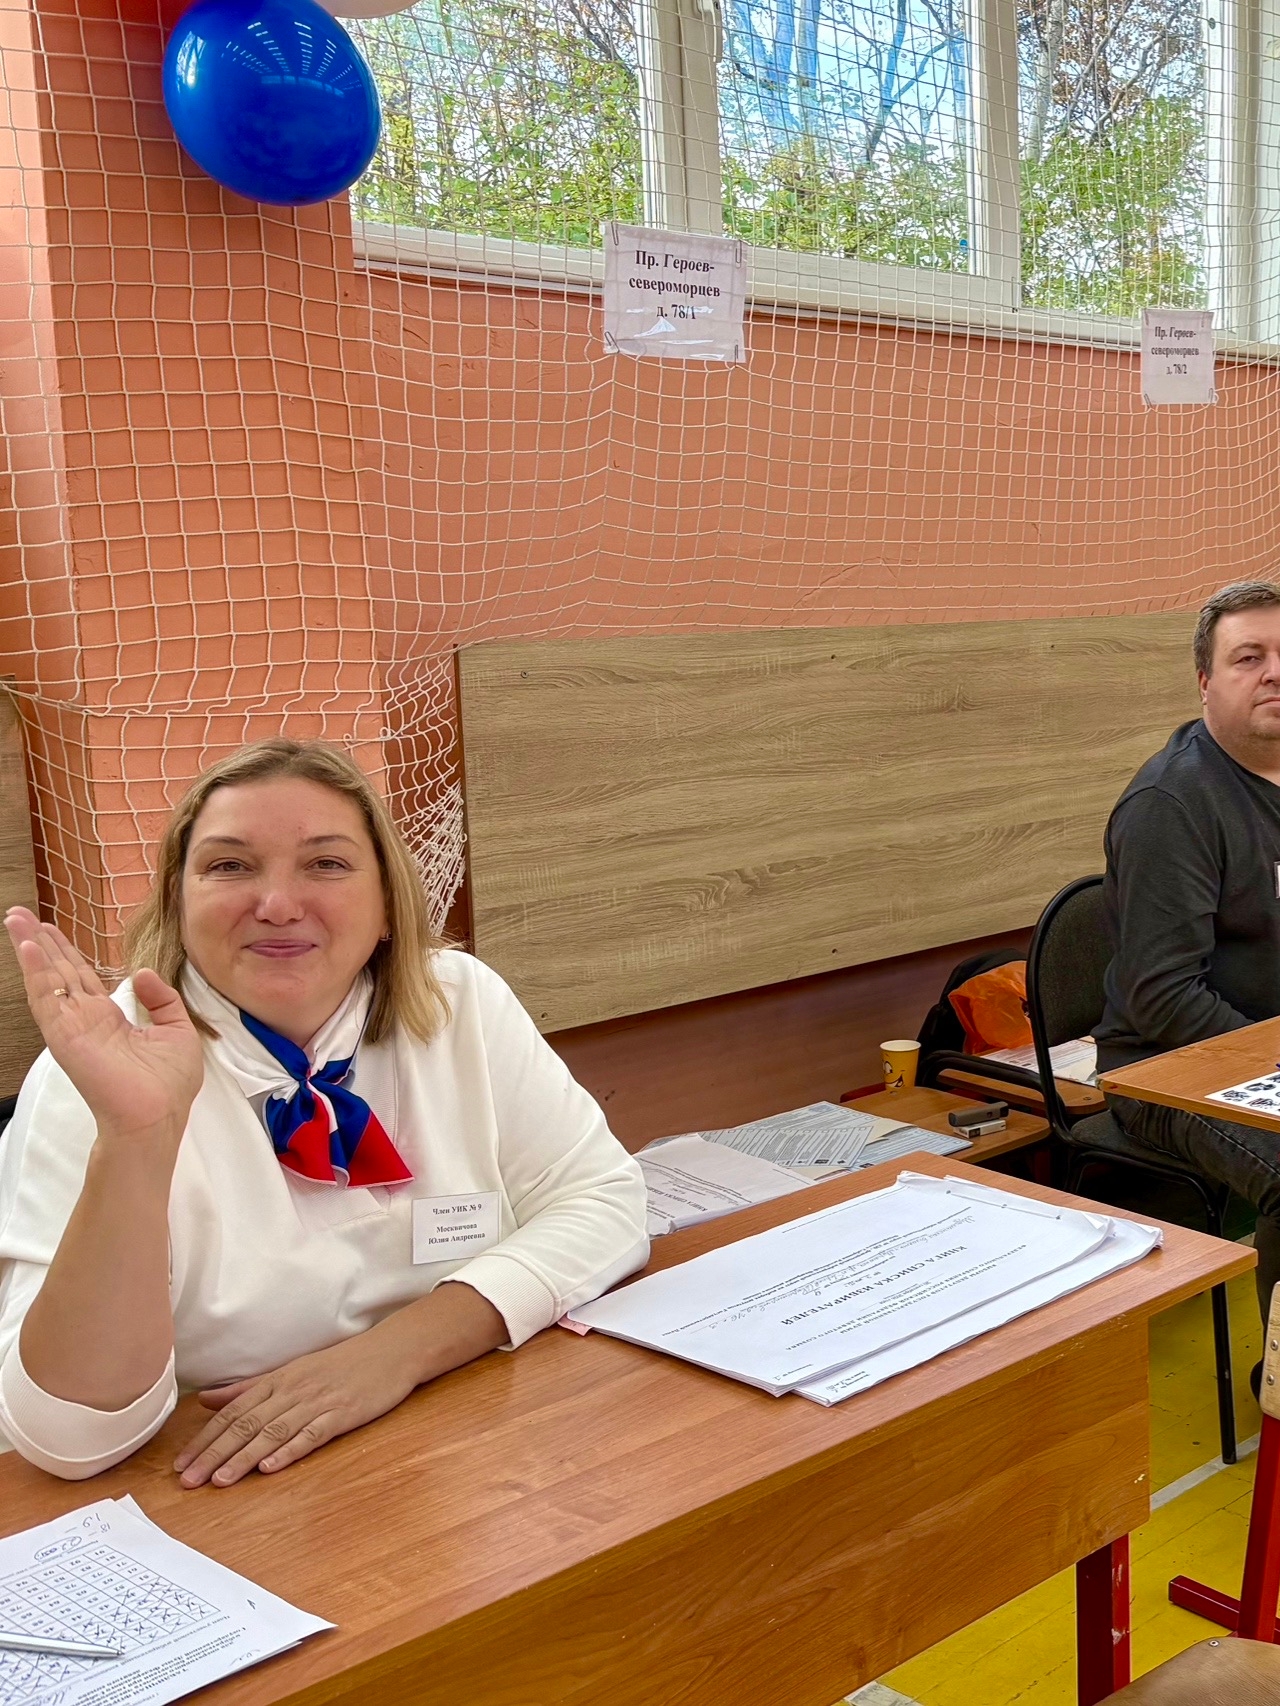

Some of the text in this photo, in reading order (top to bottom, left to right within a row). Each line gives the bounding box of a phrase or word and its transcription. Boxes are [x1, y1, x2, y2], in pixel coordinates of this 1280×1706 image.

[635, 250, 715, 273] Пр. Героев-
[629, 277, 721, 298] североморцев
[656, 304, 697, 320] д. 78/1
[1154, 326, 1168, 340] Пр.
[451, 1205, 468, 1214] УИК
[924, 1246, 967, 1262] КНИГА
[873, 1263, 925, 1285] СПИСКА
[780, 1286, 875, 1325] ИЗБИРАТЕЛЕЙ
